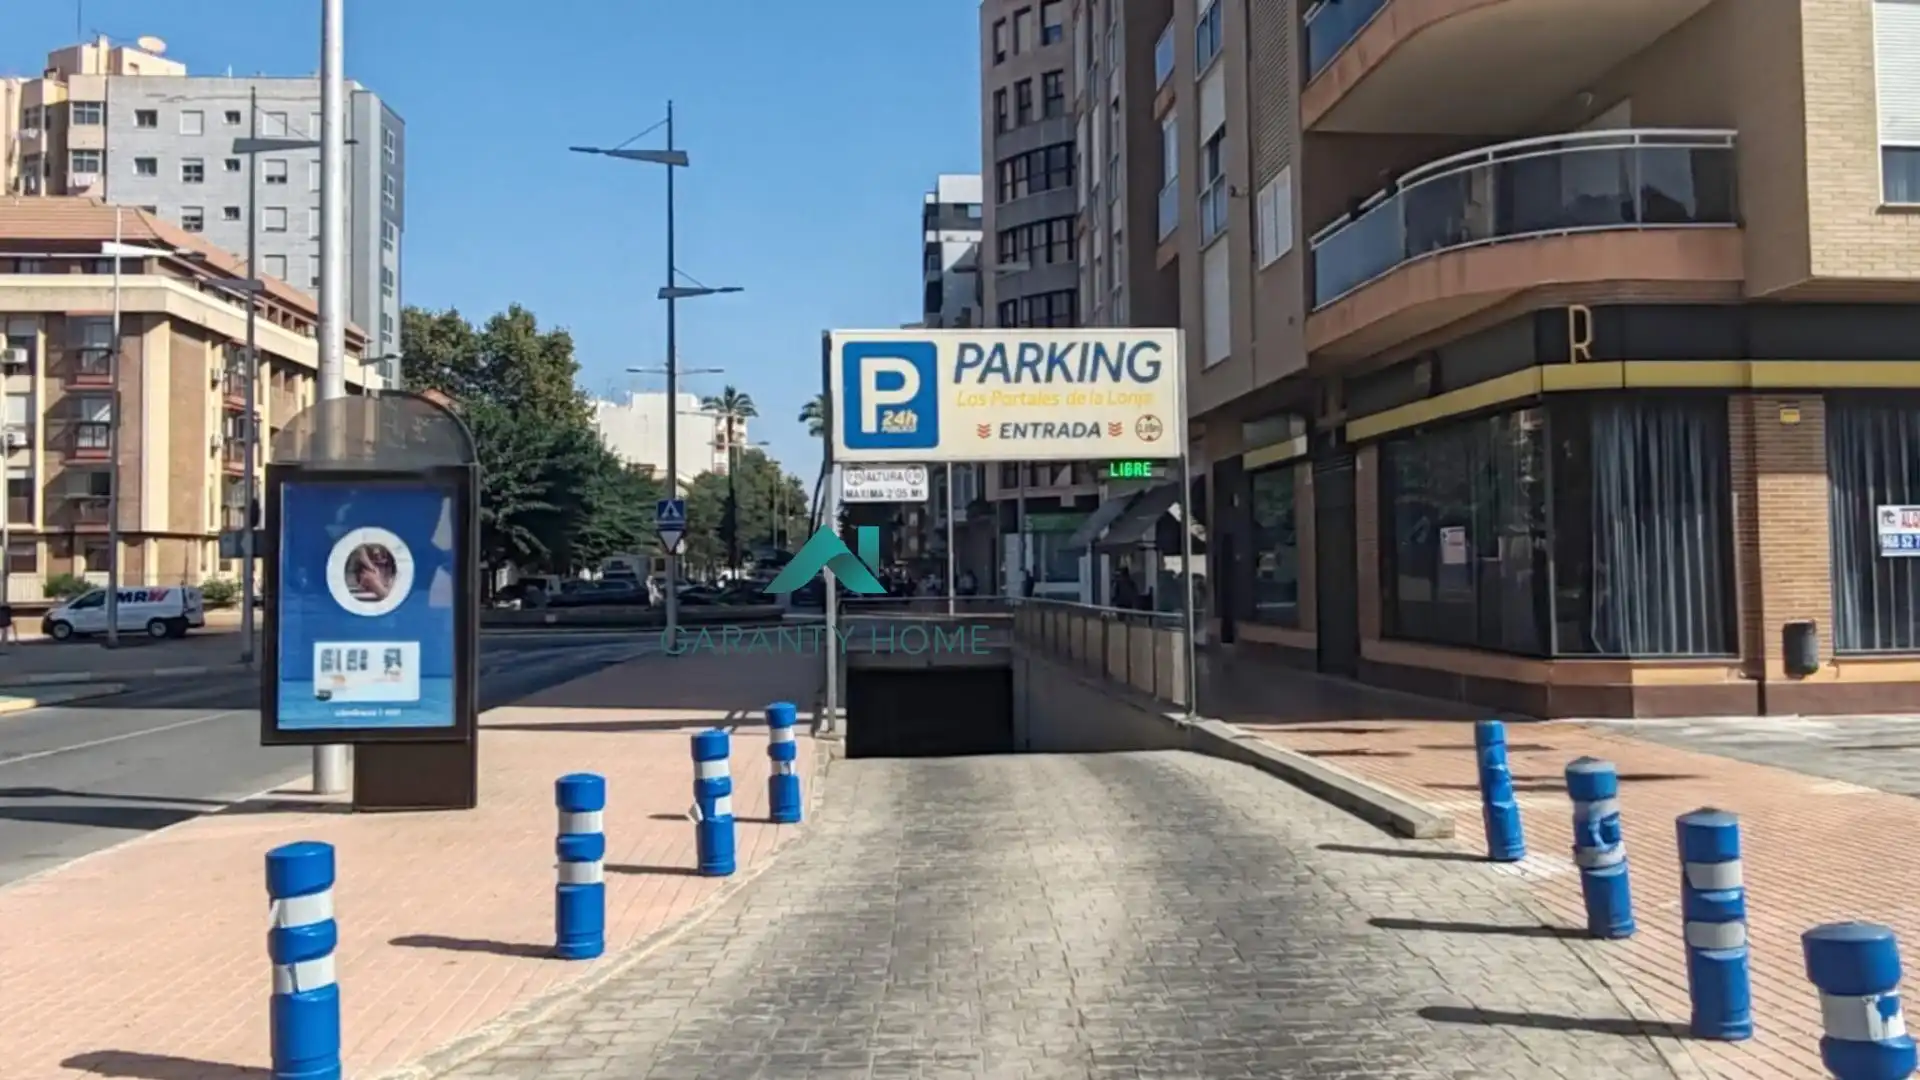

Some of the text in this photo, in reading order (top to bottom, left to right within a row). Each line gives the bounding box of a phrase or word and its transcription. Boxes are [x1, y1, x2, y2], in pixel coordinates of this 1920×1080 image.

[1568, 304, 1593, 365] R
[953, 341, 1163, 384] PARKING
[860, 357, 921, 433] P
[957, 391, 986, 407] Los
[990, 390, 1060, 407] Portales
[1066, 390, 1086, 406] de
[1089, 390, 1103, 405] la
[882, 409, 918, 427] 24h
[999, 421, 1101, 439] ENTRADA
[866, 471, 904, 482] ALTURA
[1110, 462, 1152, 477] LIBRE
[116, 588, 170, 603] MRW
